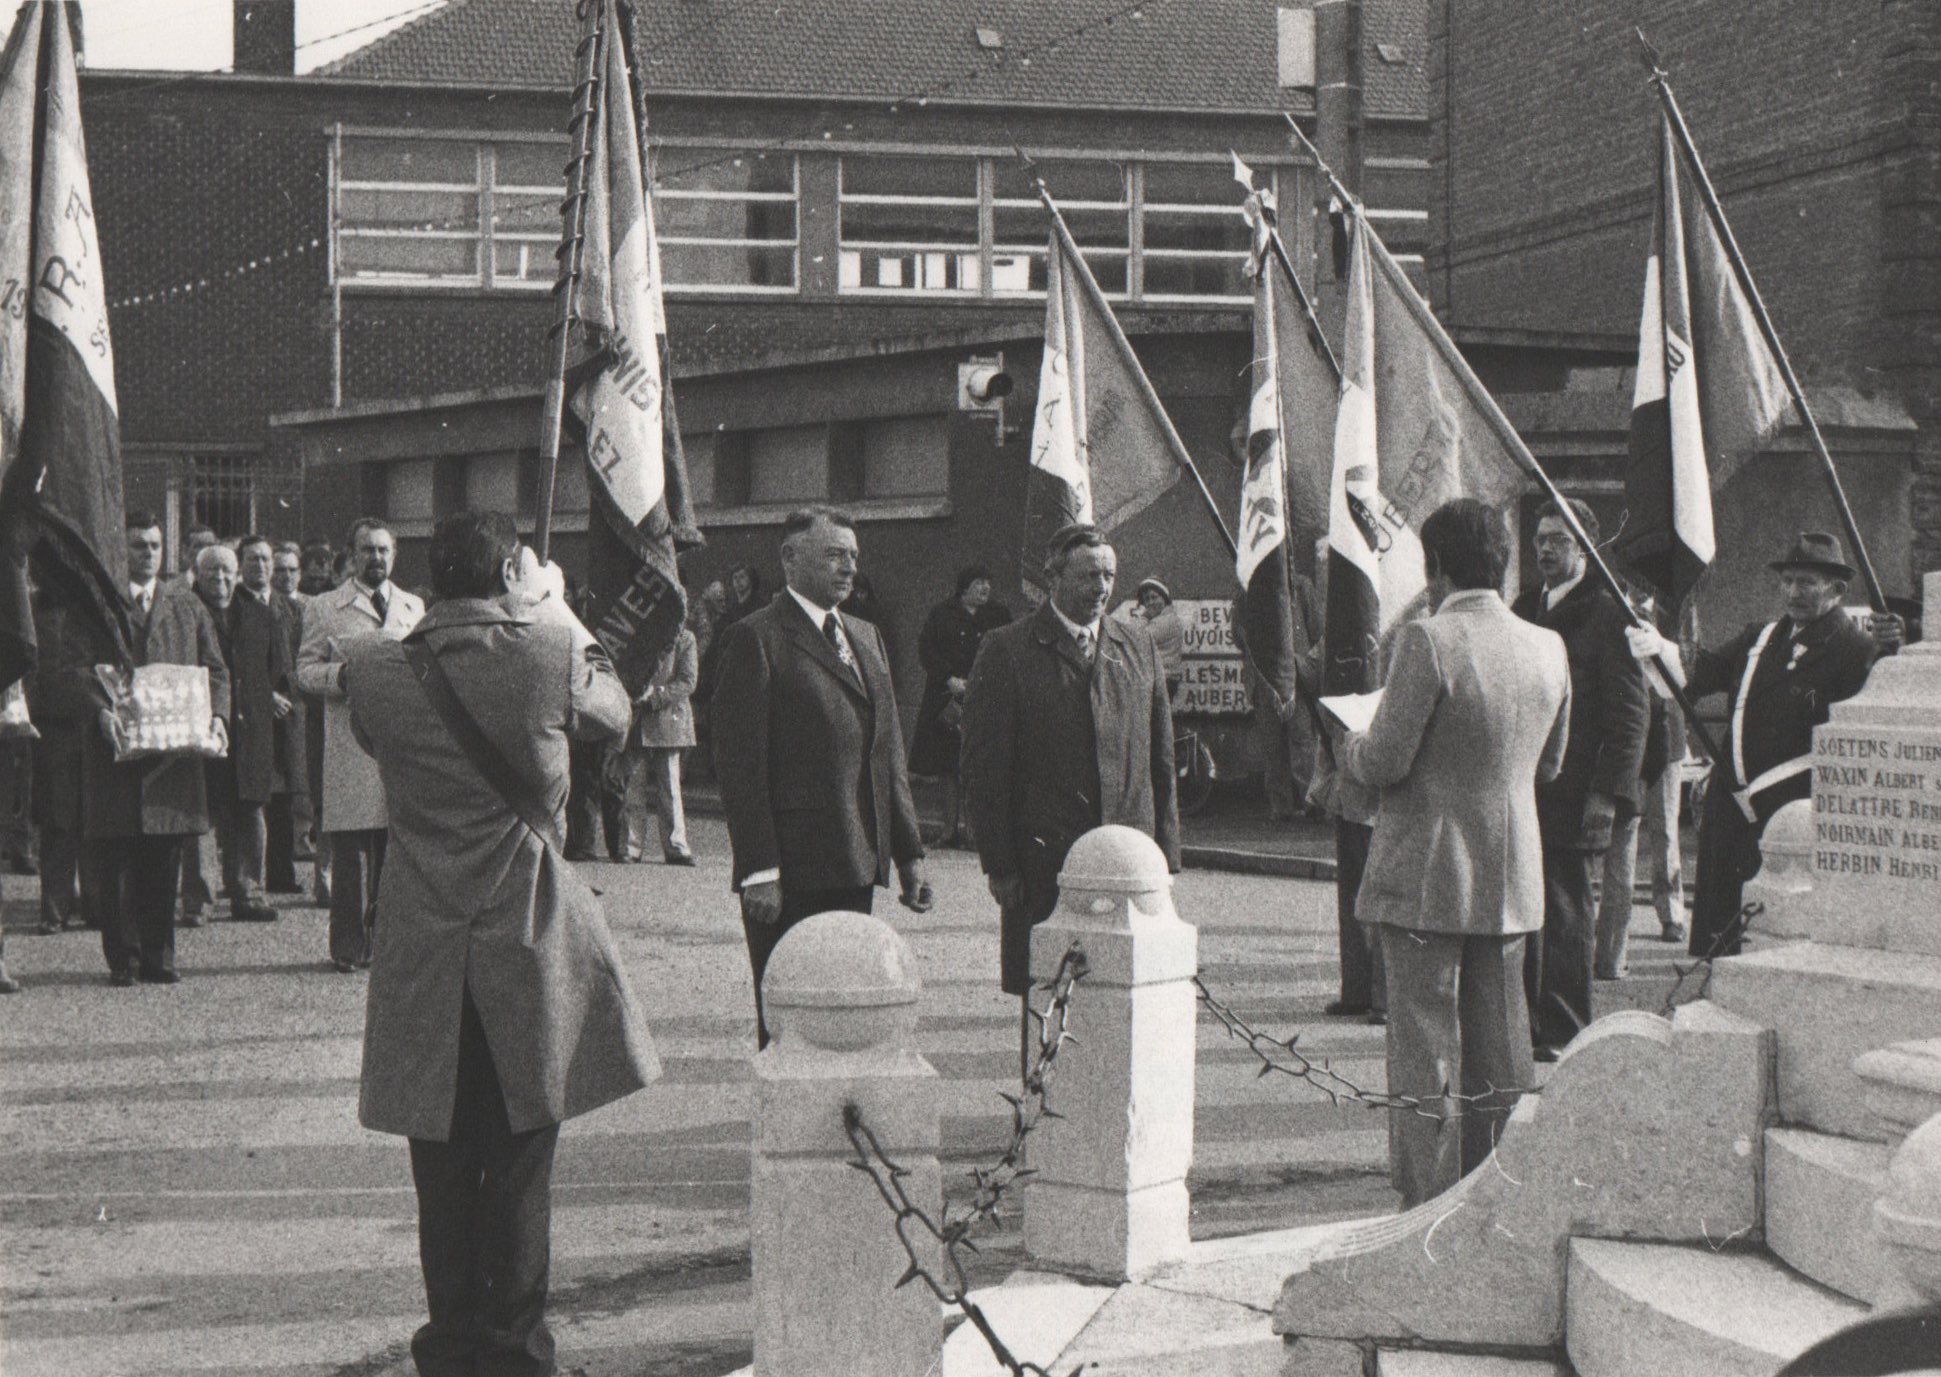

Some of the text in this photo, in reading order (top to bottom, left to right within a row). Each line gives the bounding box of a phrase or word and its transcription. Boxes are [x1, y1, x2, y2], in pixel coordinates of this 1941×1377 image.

[1818, 738, 1888, 758] SOETENS
[1817, 765, 1867, 787] WAXIN
[1873, 771, 1925, 790] ALBERT
[1815, 794, 1902, 818] DELATTRE
[1816, 823, 1894, 847] NOIRMAIN
[1816, 851, 1939, 881] HERBIN HENRI
